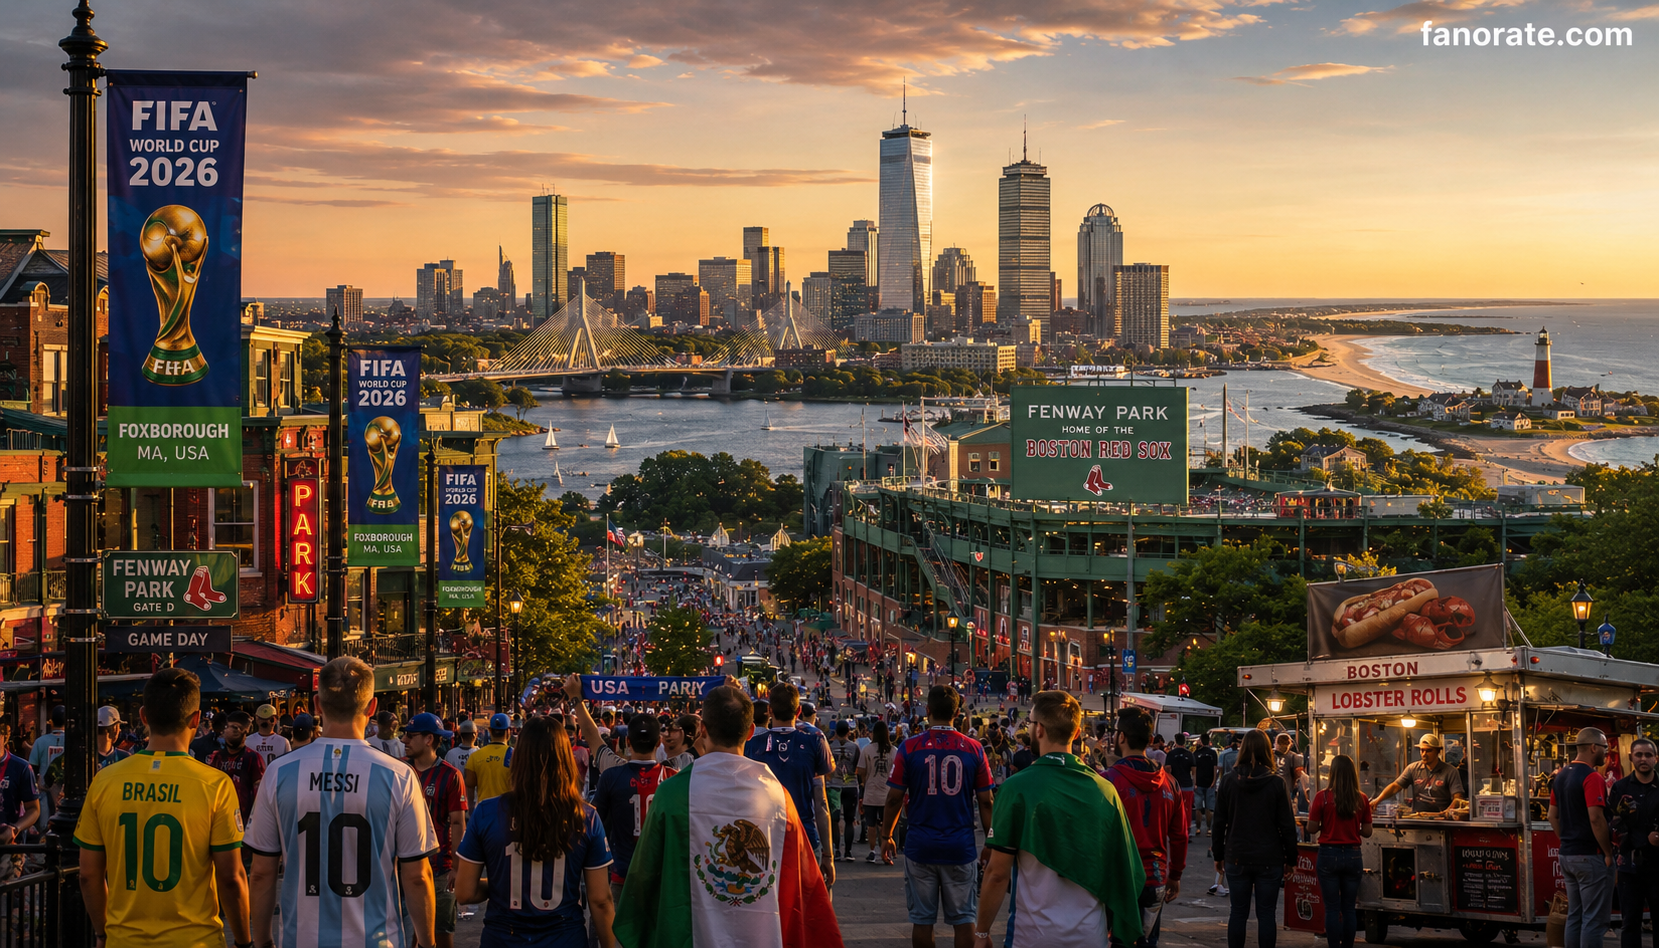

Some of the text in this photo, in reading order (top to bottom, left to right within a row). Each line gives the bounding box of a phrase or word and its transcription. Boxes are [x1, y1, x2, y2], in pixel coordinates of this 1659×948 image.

[131, 100, 218, 131] FIFA
[129, 139, 220, 153] WORLD CUP
[129, 157, 219, 187] 2026
[359, 359, 406, 377] FIFA
[358, 380, 407, 388] WORLD CUP
[358, 390, 407, 407] 2026
[1028, 404, 1169, 420] FENWAY PARK
[118, 422, 229, 439] FOXBOROUGH
[1061, 425, 1134, 435] HOME OF THE
[137, 445, 209, 462] MA, USA
[1026, 438, 1172, 460] BOSTON RED SOX
[445, 473, 477, 486] FIFA
[445, 493, 477, 505] 2026
[293, 484, 313, 595] PARK
[354, 533, 413, 542] FOXBOROUGH
[363, 544, 402, 553] MA, USA
[112, 559, 191, 577] FENWAY
[124, 581, 175, 598] PARK
[133, 602, 175, 612] GATE D
[127, 632, 209, 647] GAME DAY
[1347, 661, 1419, 680] BOSTON
[590, 679, 630, 695] USA
[1331, 685, 1467, 710] LOBSTER ROLLS
[309, 771, 359, 793] MESSI
[923, 753, 964, 796] 10
[122, 781, 182, 803] BRASIL
[118, 811, 184, 893] 10
[297, 811, 372, 897] 10
[504, 840, 566, 911] 10
